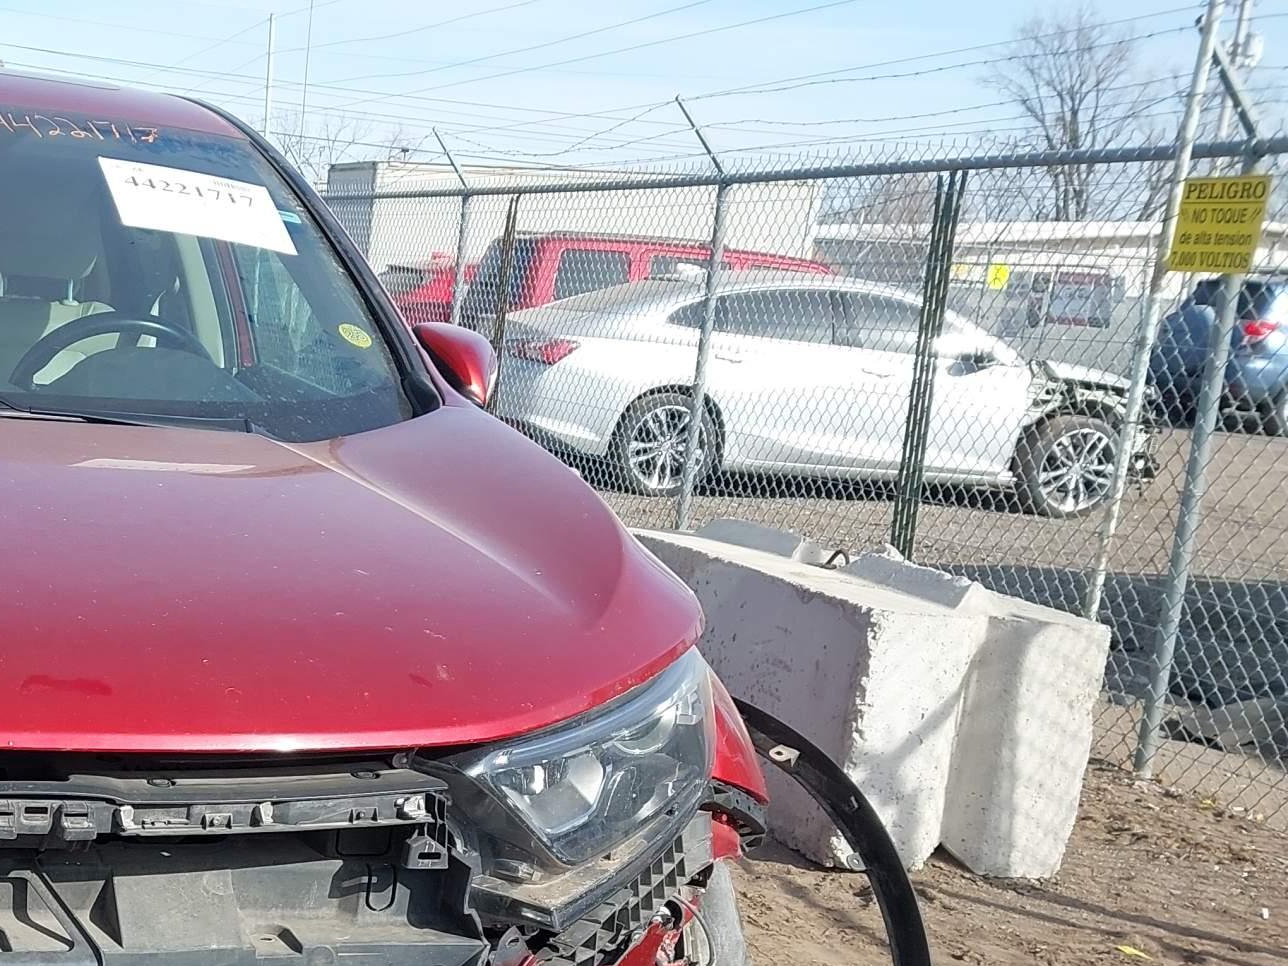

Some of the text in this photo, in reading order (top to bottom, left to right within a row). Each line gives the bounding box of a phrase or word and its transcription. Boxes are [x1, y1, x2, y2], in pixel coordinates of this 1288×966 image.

[124, 175, 253, 207] 44221717
[1185, 181, 1266, 200] PELIGRO
[1191, 207, 1248, 224] NO TOQUE
[1179, 231, 1193, 245] de
[1193, 231, 1212, 246] alta
[1199, 251, 1250, 269] VOLTIOS
